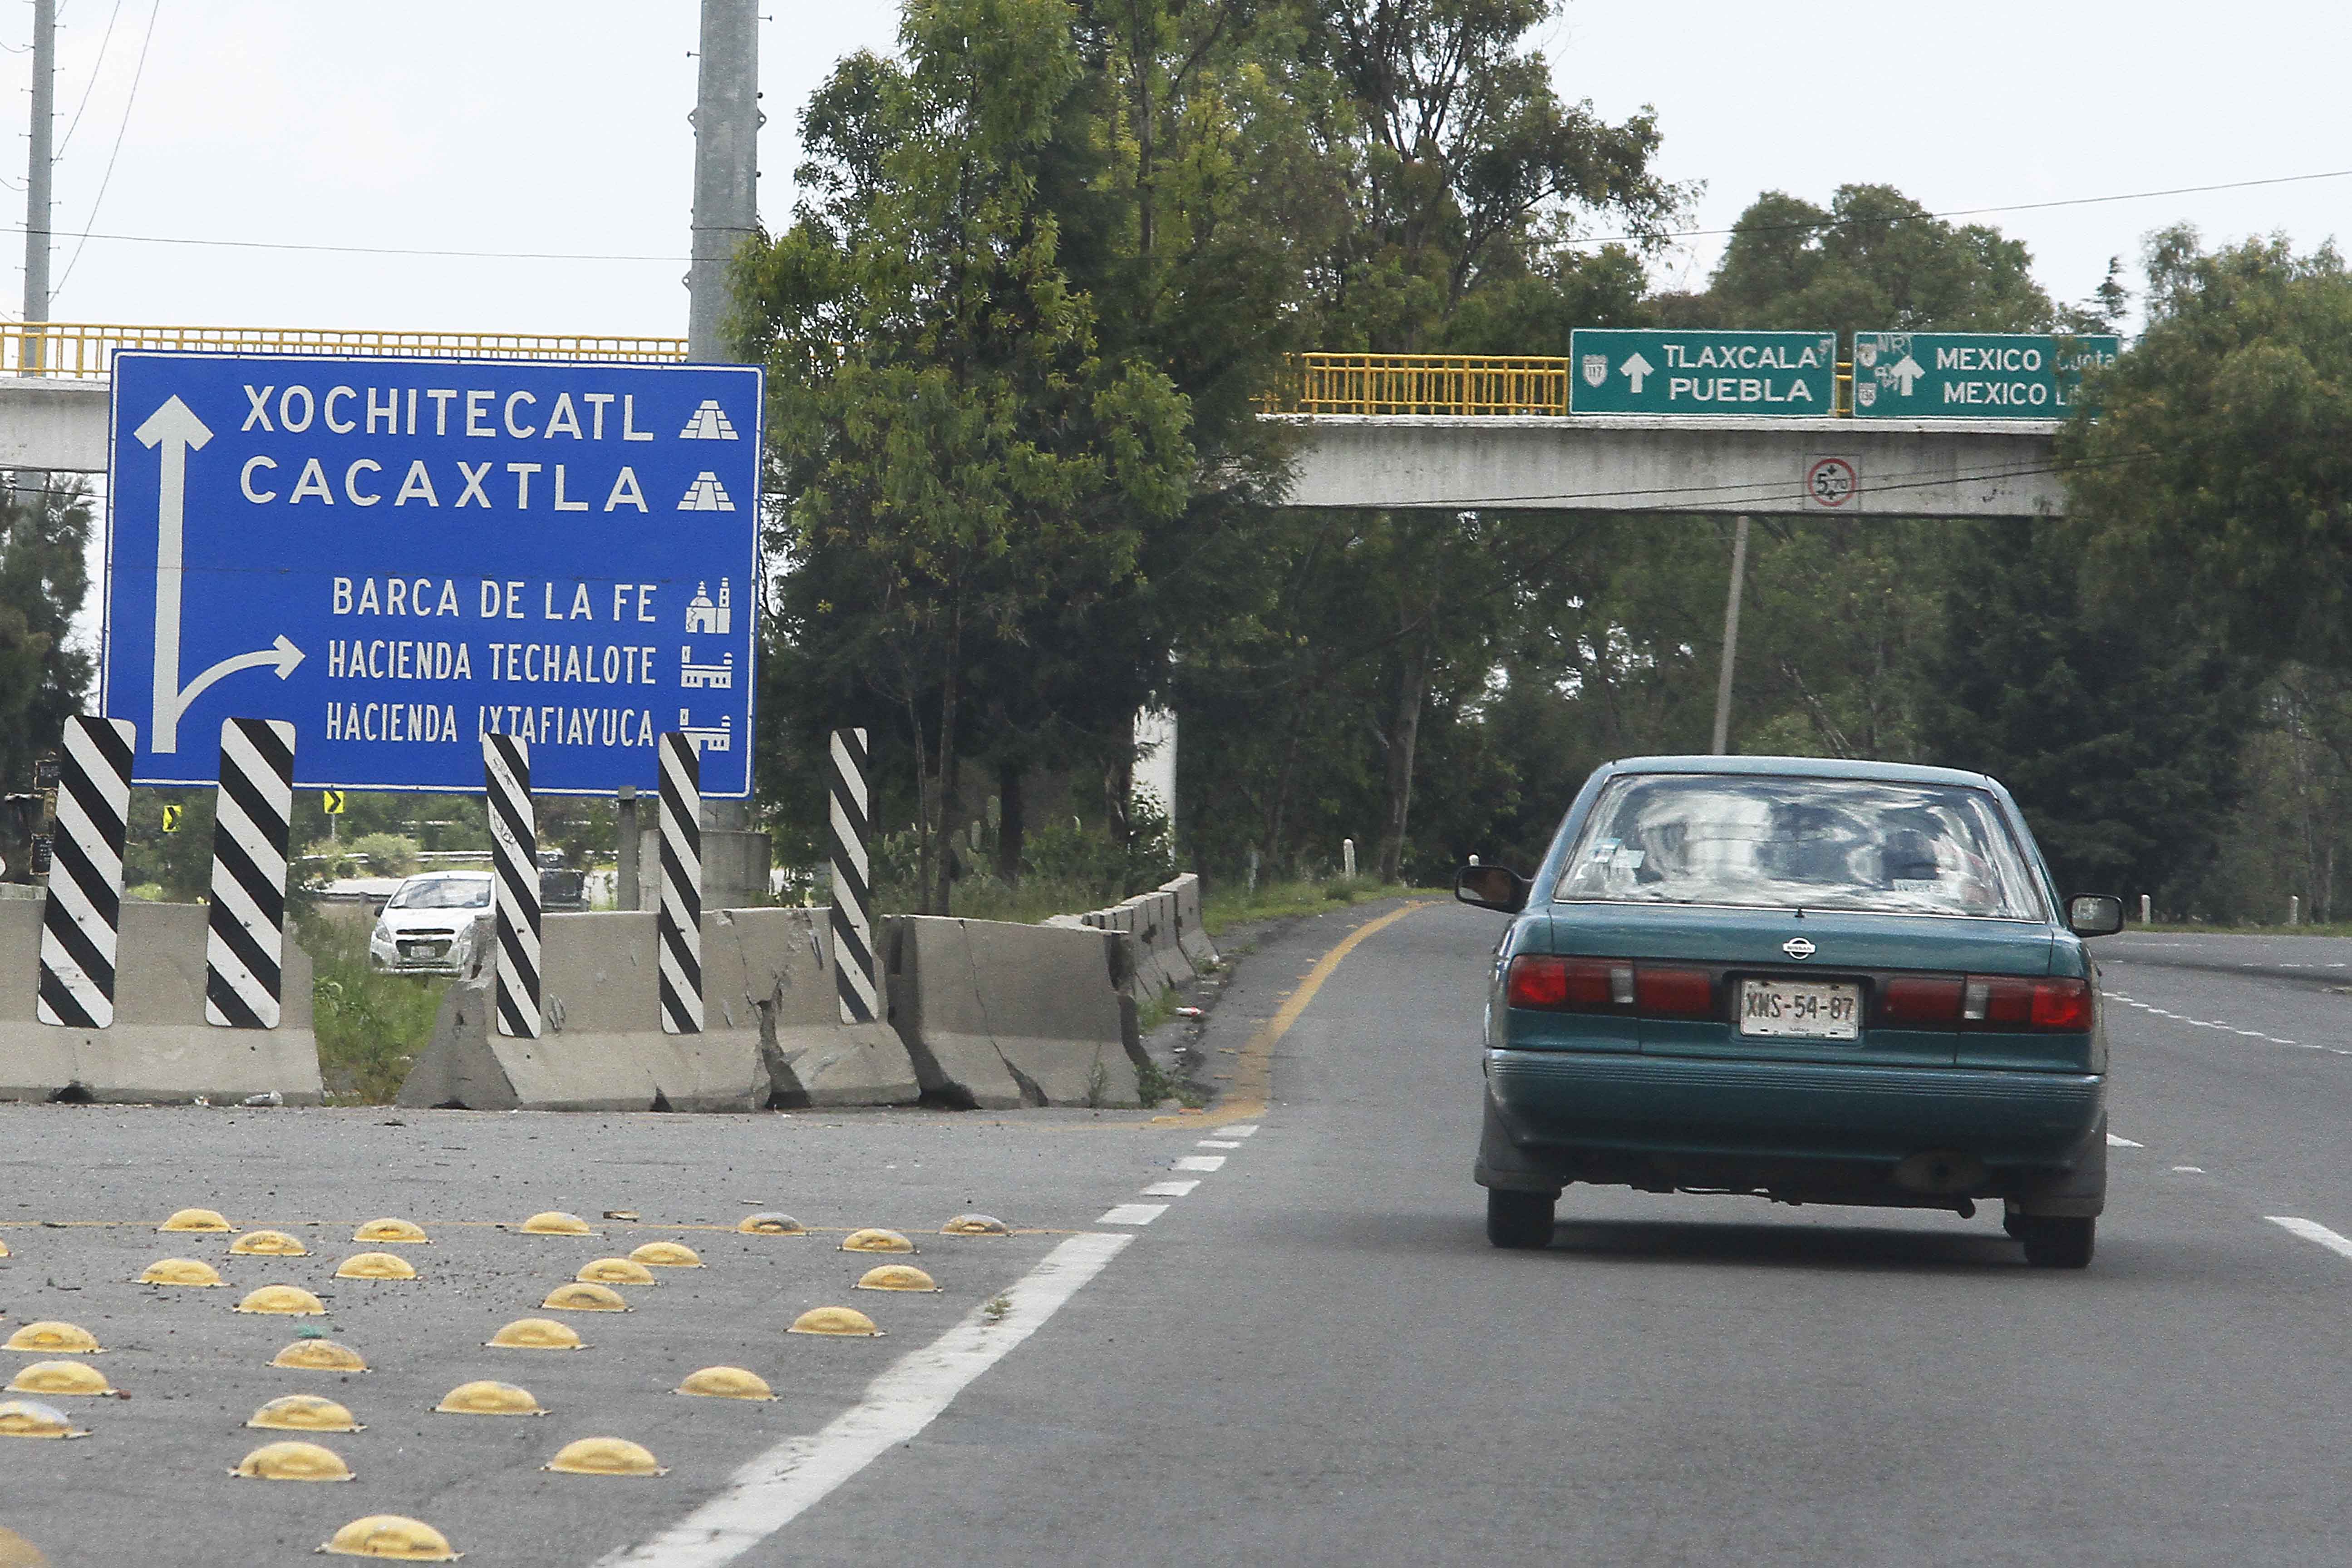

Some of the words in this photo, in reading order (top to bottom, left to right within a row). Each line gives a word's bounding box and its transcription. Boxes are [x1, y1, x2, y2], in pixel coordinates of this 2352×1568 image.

[1663, 344, 1819, 369] TLAXCALA
[1937, 347, 2042, 372] MEXICO
[1669, 378, 1813, 402] PUEBLA
[1944, 382, 2047, 405] MEXICO
[241, 385, 654, 442] XOCHITECATL
[240, 455, 649, 513] CACAXTLA
[333, 577, 459, 617] BARCA
[480, 580, 525, 619] DE
[545, 582, 593, 621] LA
[613, 584, 657, 623] FE
[328, 640, 472, 680] HACIENDA
[488, 644, 657, 684] TECHALOTE
[326, 702, 458, 743] HACIENDA
[479, 705, 654, 747] IXTAFIAYUCA
